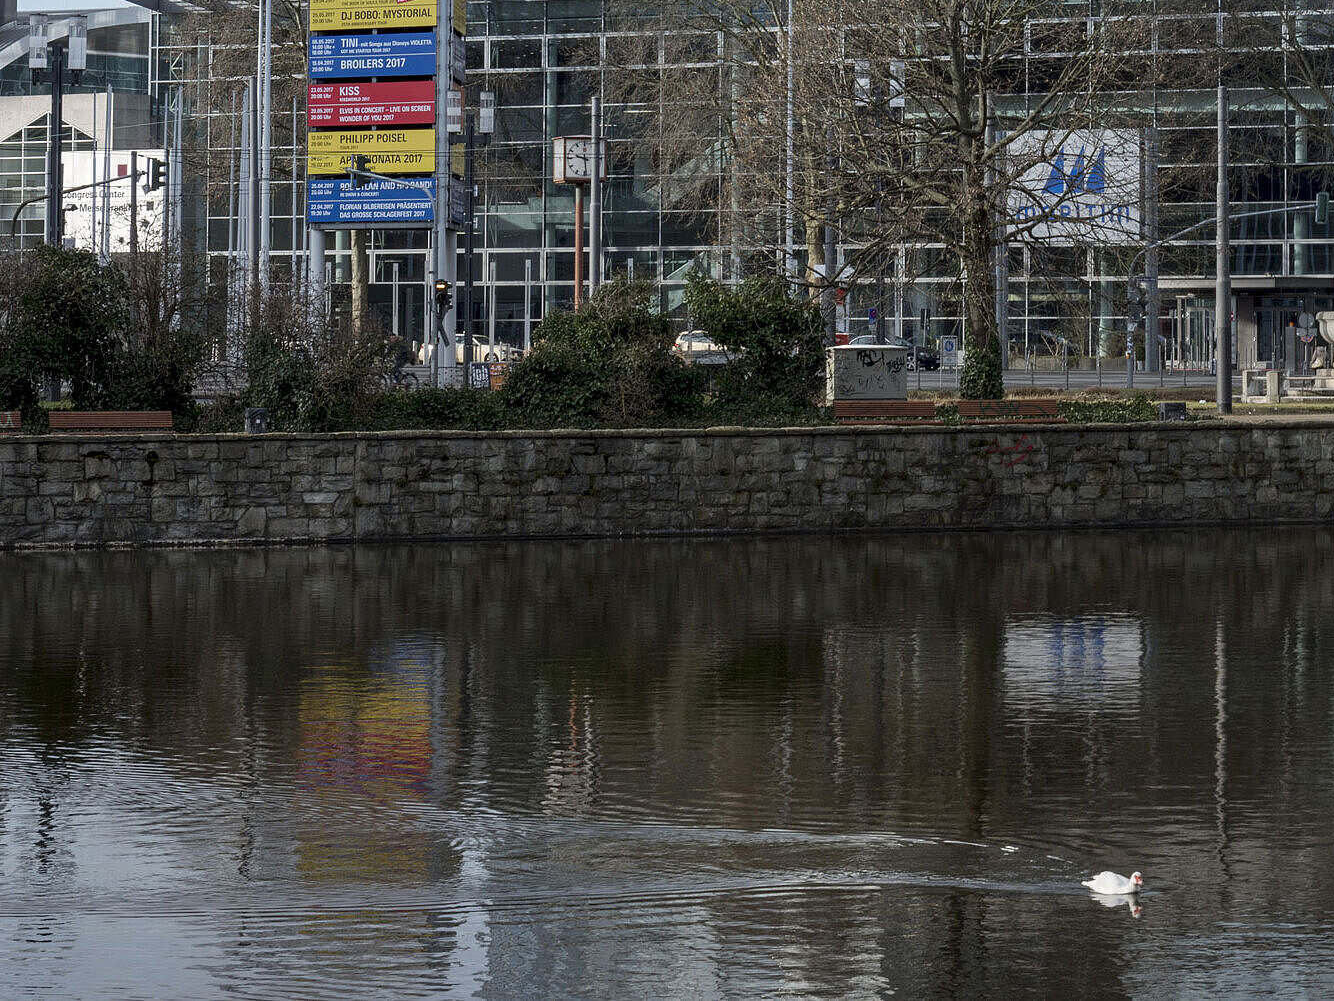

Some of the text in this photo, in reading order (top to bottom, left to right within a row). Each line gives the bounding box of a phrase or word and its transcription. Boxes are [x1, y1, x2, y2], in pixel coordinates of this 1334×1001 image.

[341, 8, 432, 20] DJ BOBO: MYSTORIAL
[341, 38, 358, 47] TINI
[341, 58, 405, 69] BROILERS 2017
[340, 86, 360, 95] KISS
[340, 133, 407, 143] PHILIPP POISEL
[340, 154, 401, 164] APIONATA
[404, 154, 422, 163] 2017
[356, 182, 378, 190] LAN
[379, 182, 395, 190] AND
[99, 190, 125, 199] Cnter
[80, 203, 142, 212] Mese rankft
[363, 202, 395, 210] SILBEREISEN
[396, 201, 431, 209] PRÄSENTIERT
[373, 210, 412, 218] SCHLAGERFEST
